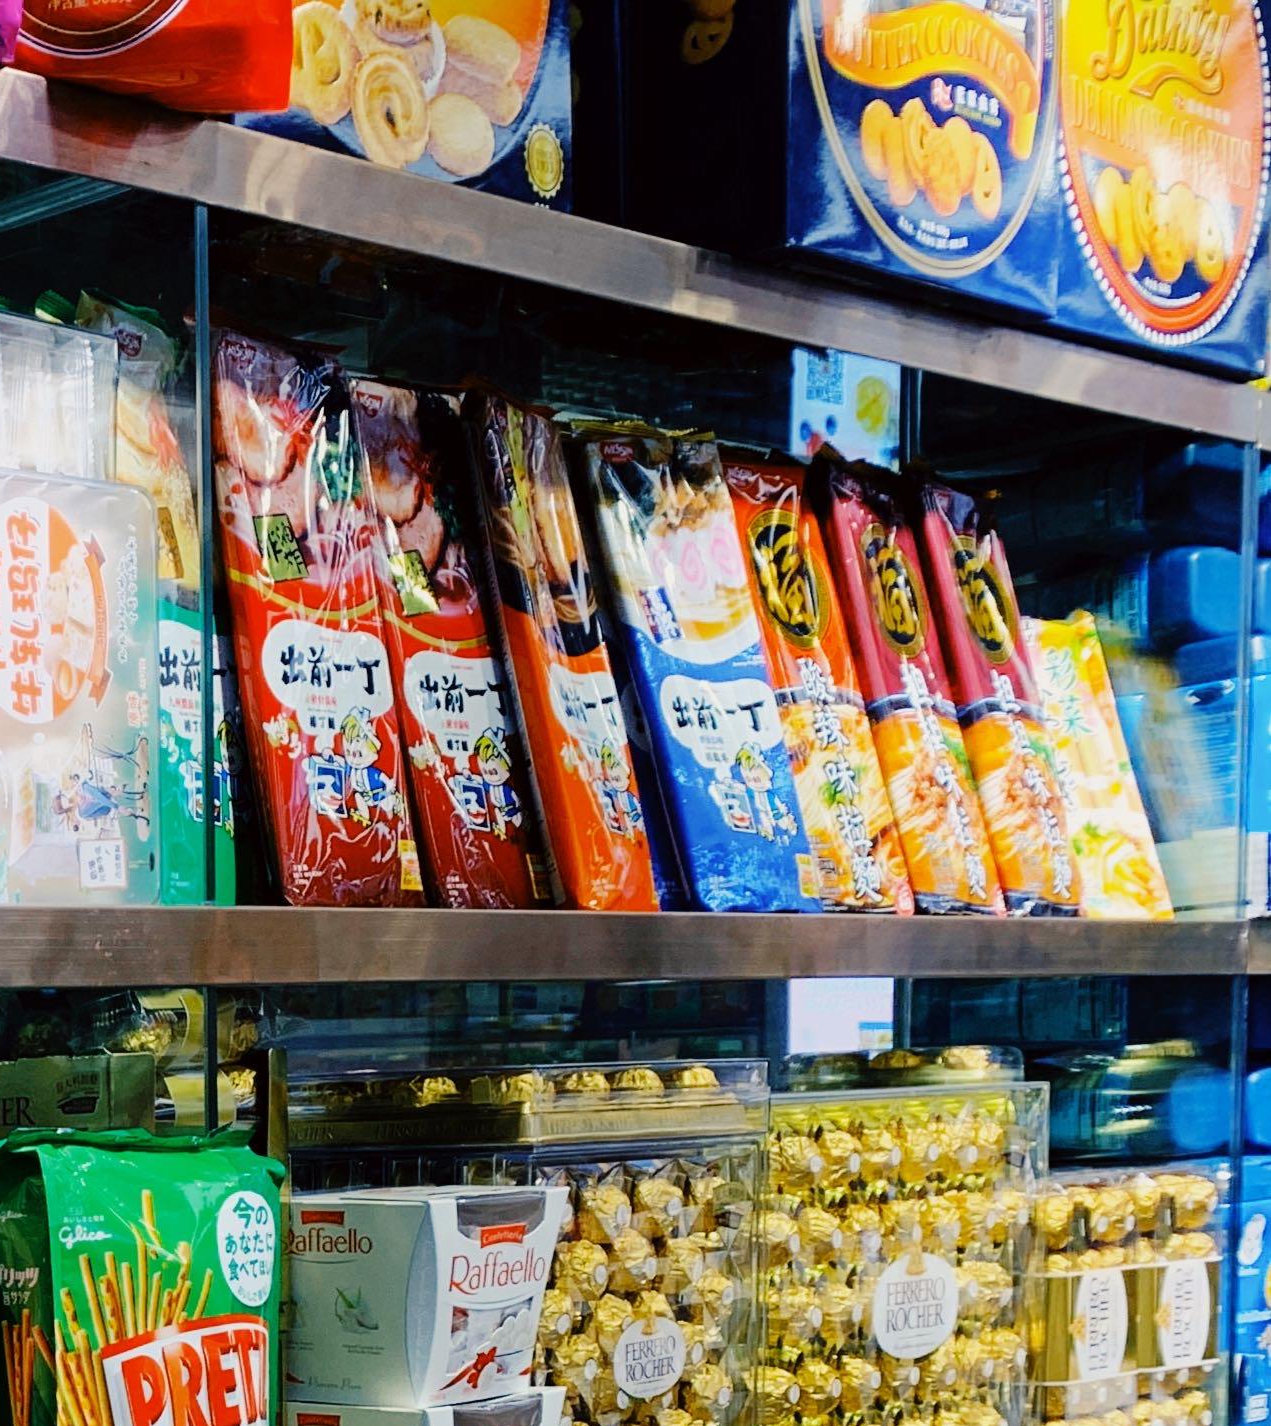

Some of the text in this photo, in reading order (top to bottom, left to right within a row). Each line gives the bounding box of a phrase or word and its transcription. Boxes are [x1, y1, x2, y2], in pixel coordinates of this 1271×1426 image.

[928, 17, 1024, 88] COOKIES
[281, 644, 379, 695] 出前一丁
[448, 1253, 545, 1294] Raffaello
[886, 1277, 946, 1305] FERRERO
[885, 1302, 944, 1332] ROCHER
[624, 1336, 677, 1359] FERRERO
[626, 1356, 680, 1381] ROCHER
